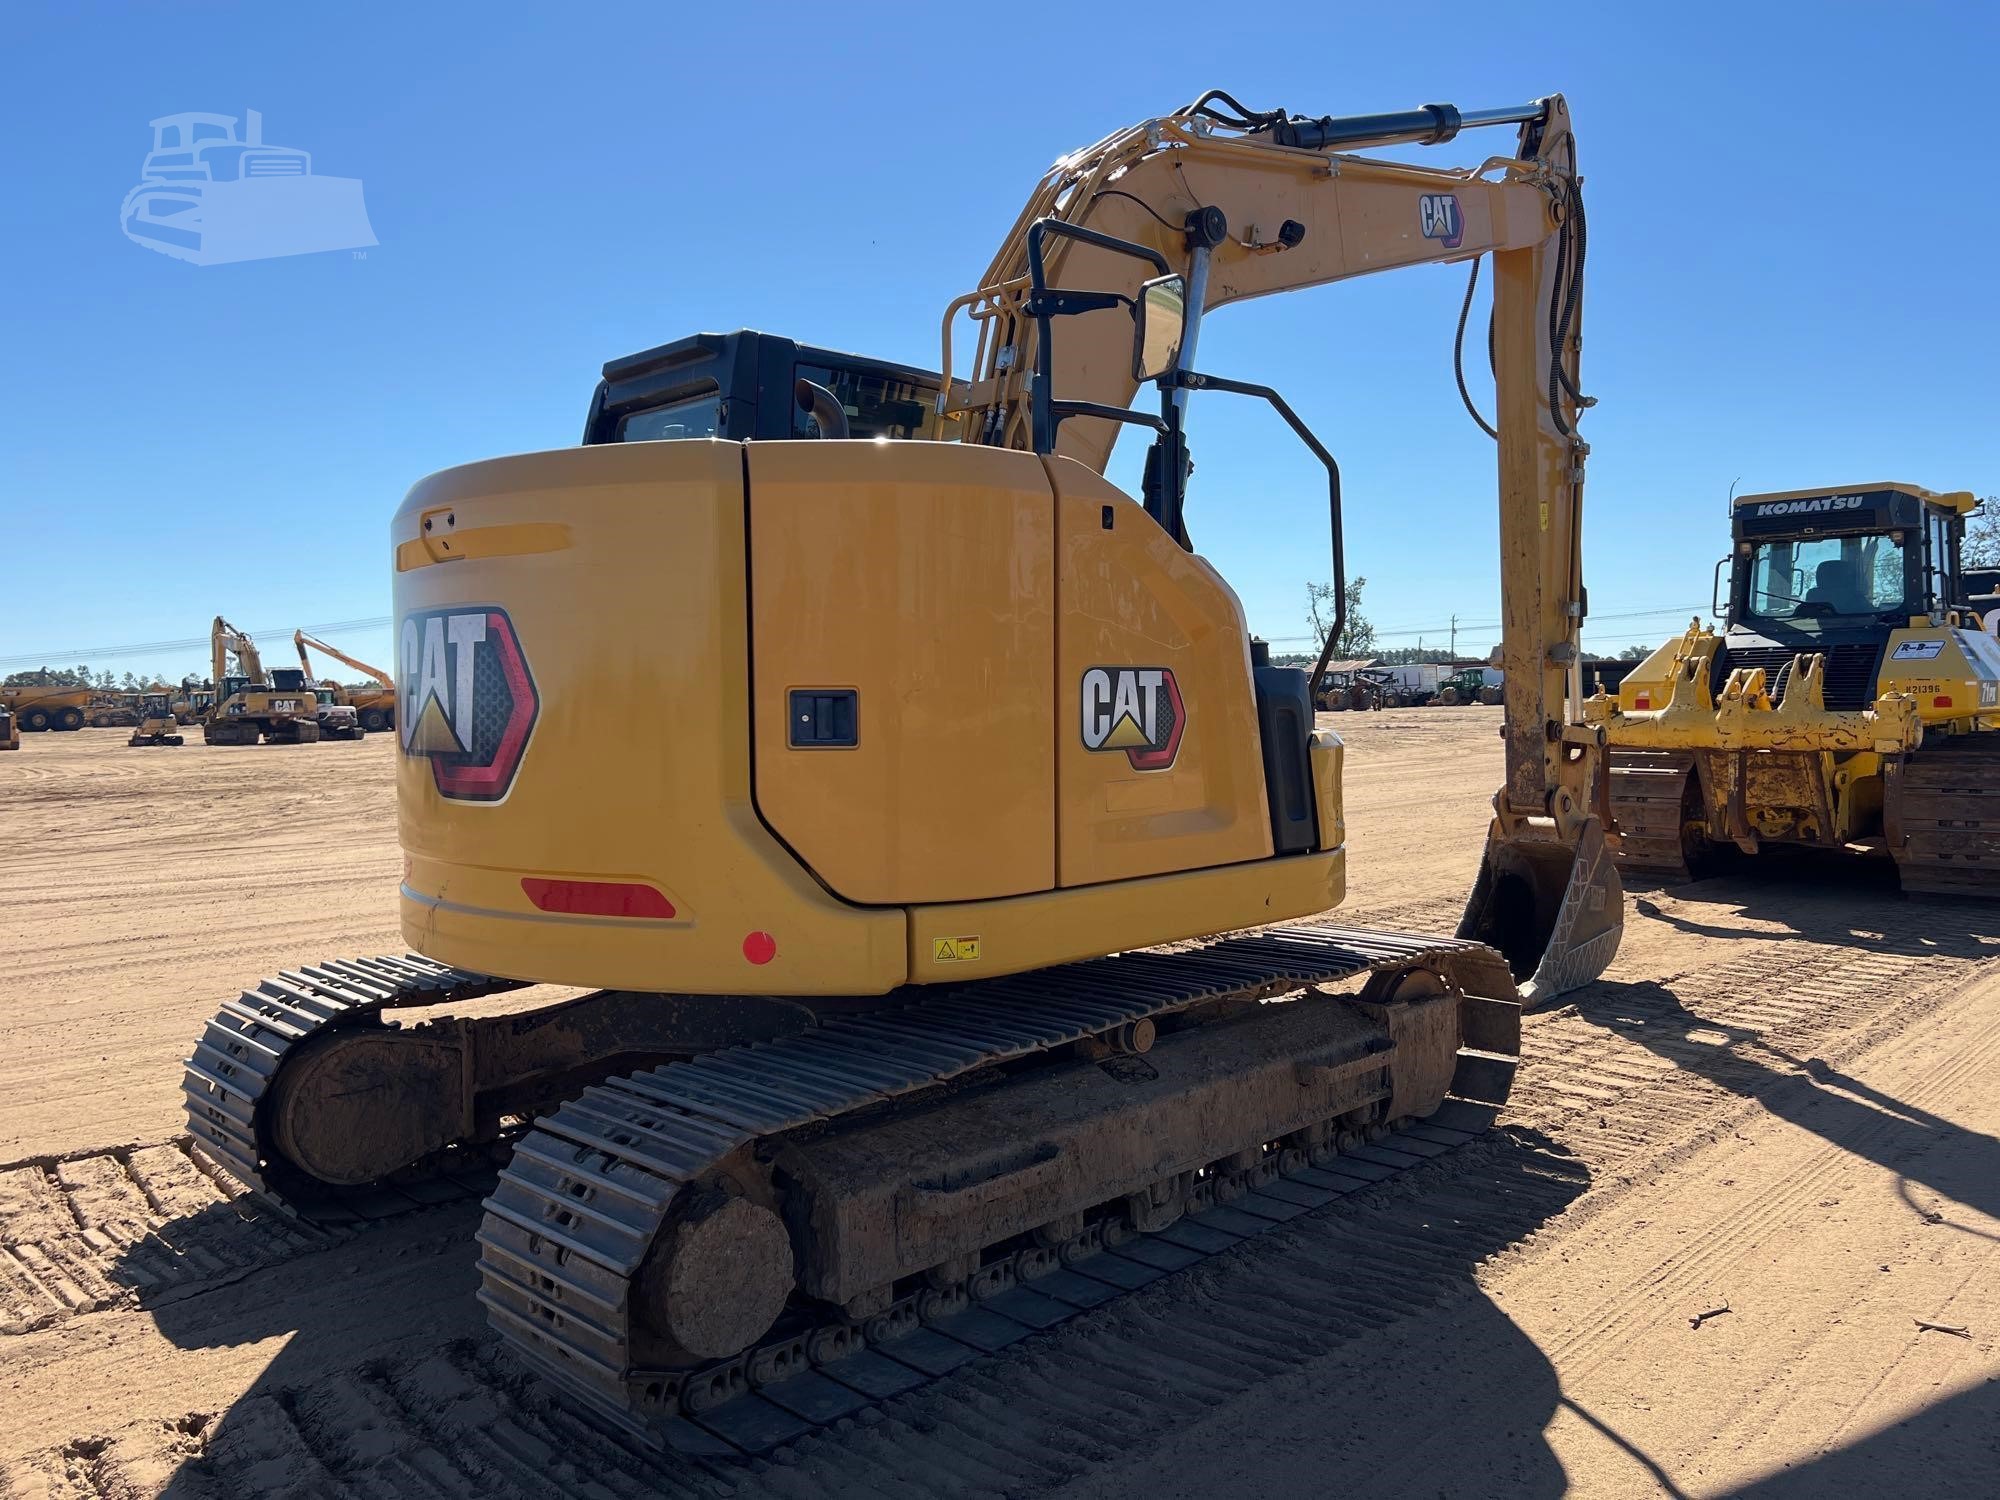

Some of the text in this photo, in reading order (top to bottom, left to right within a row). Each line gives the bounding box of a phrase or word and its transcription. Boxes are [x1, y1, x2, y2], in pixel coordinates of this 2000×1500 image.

[1420, 196, 1453, 237] CAT
[1757, 495, 1863, 516] KOMATSU
[400, 613, 487, 752] CAT
[274, 700, 297, 713] CAT
[1082, 669, 1163, 749] CAT
